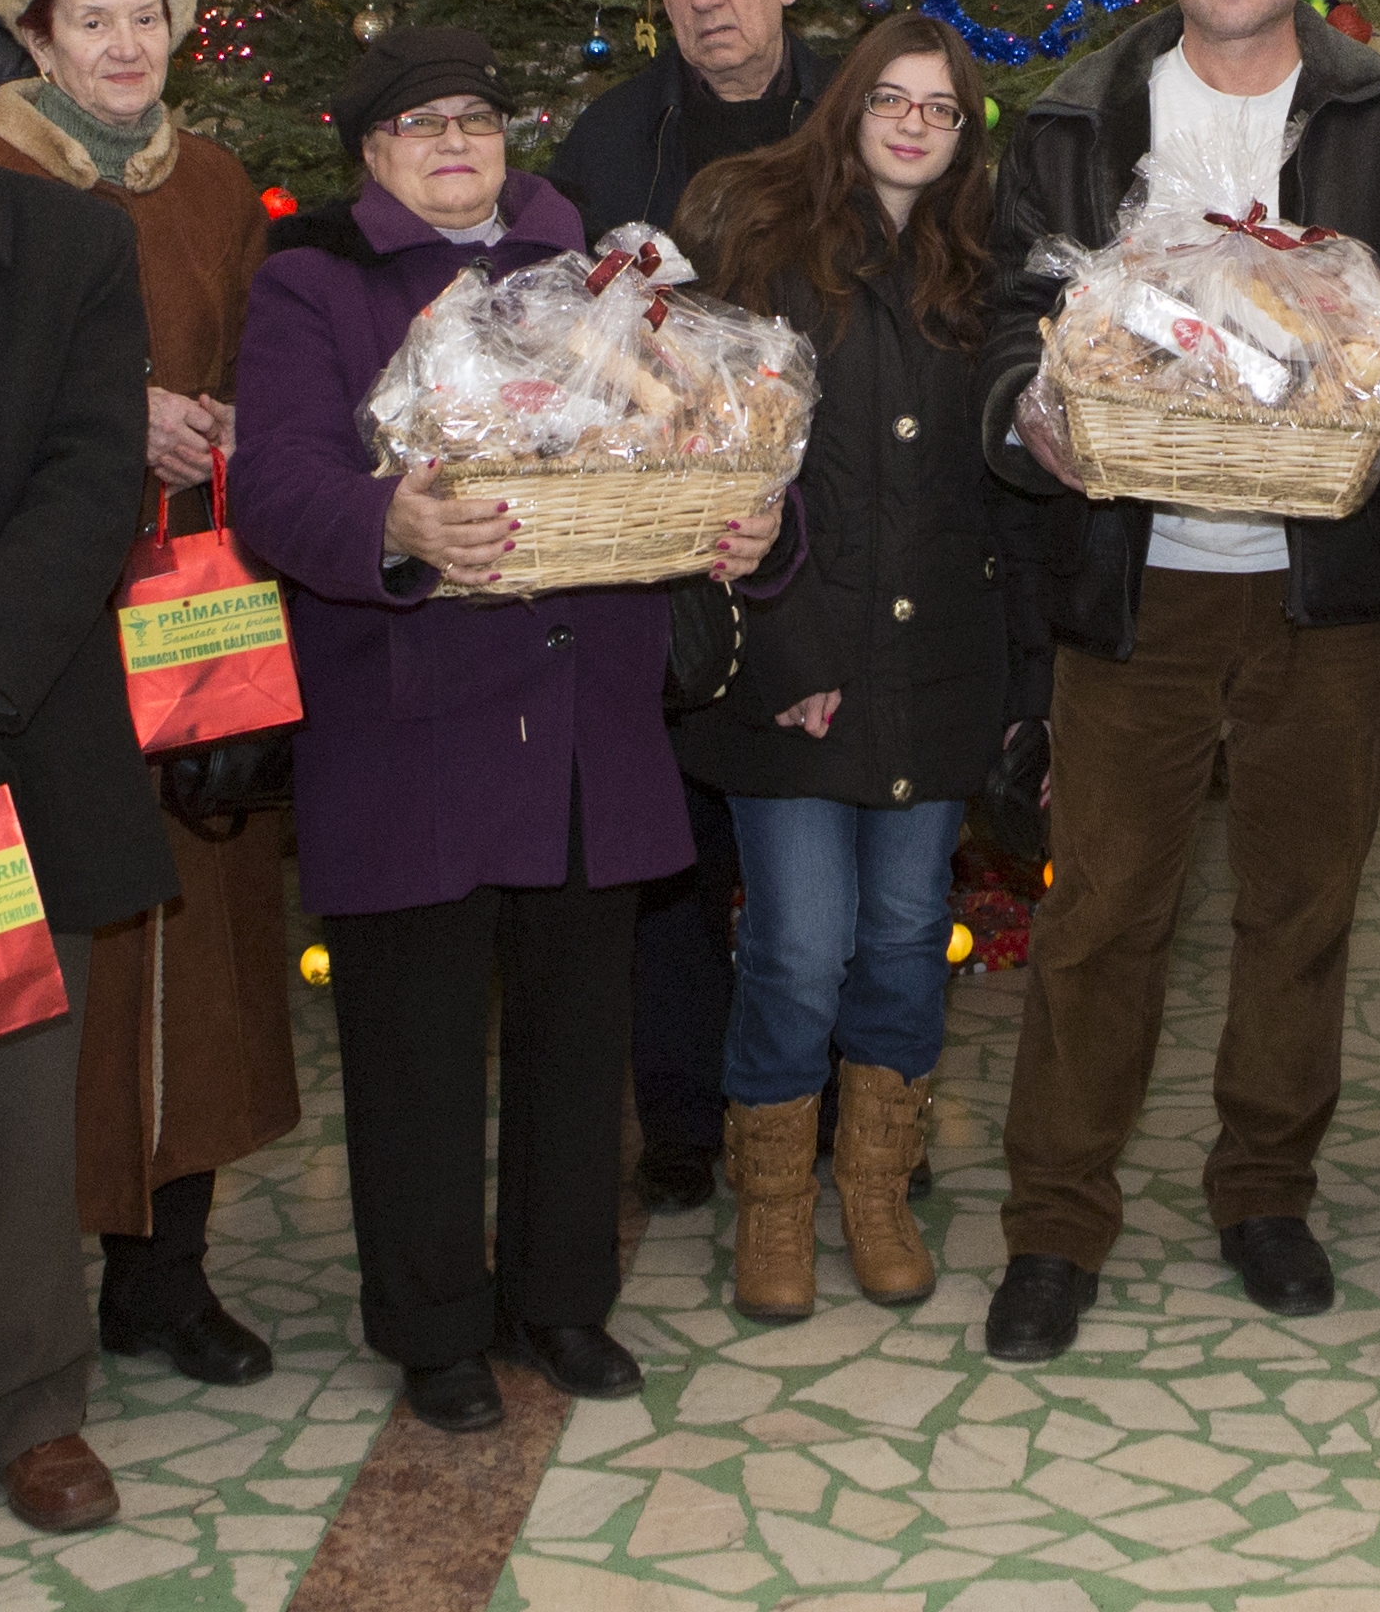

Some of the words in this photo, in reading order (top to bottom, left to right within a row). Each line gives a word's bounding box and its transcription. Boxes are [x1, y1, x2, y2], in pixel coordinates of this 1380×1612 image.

[157, 591, 279, 628] PRIMAFARM
[222, 622, 241, 633] din
[245, 615, 281, 631] prima
[131, 652, 178, 670] FARMACIA
[180, 642, 223, 661] TUTUROR
